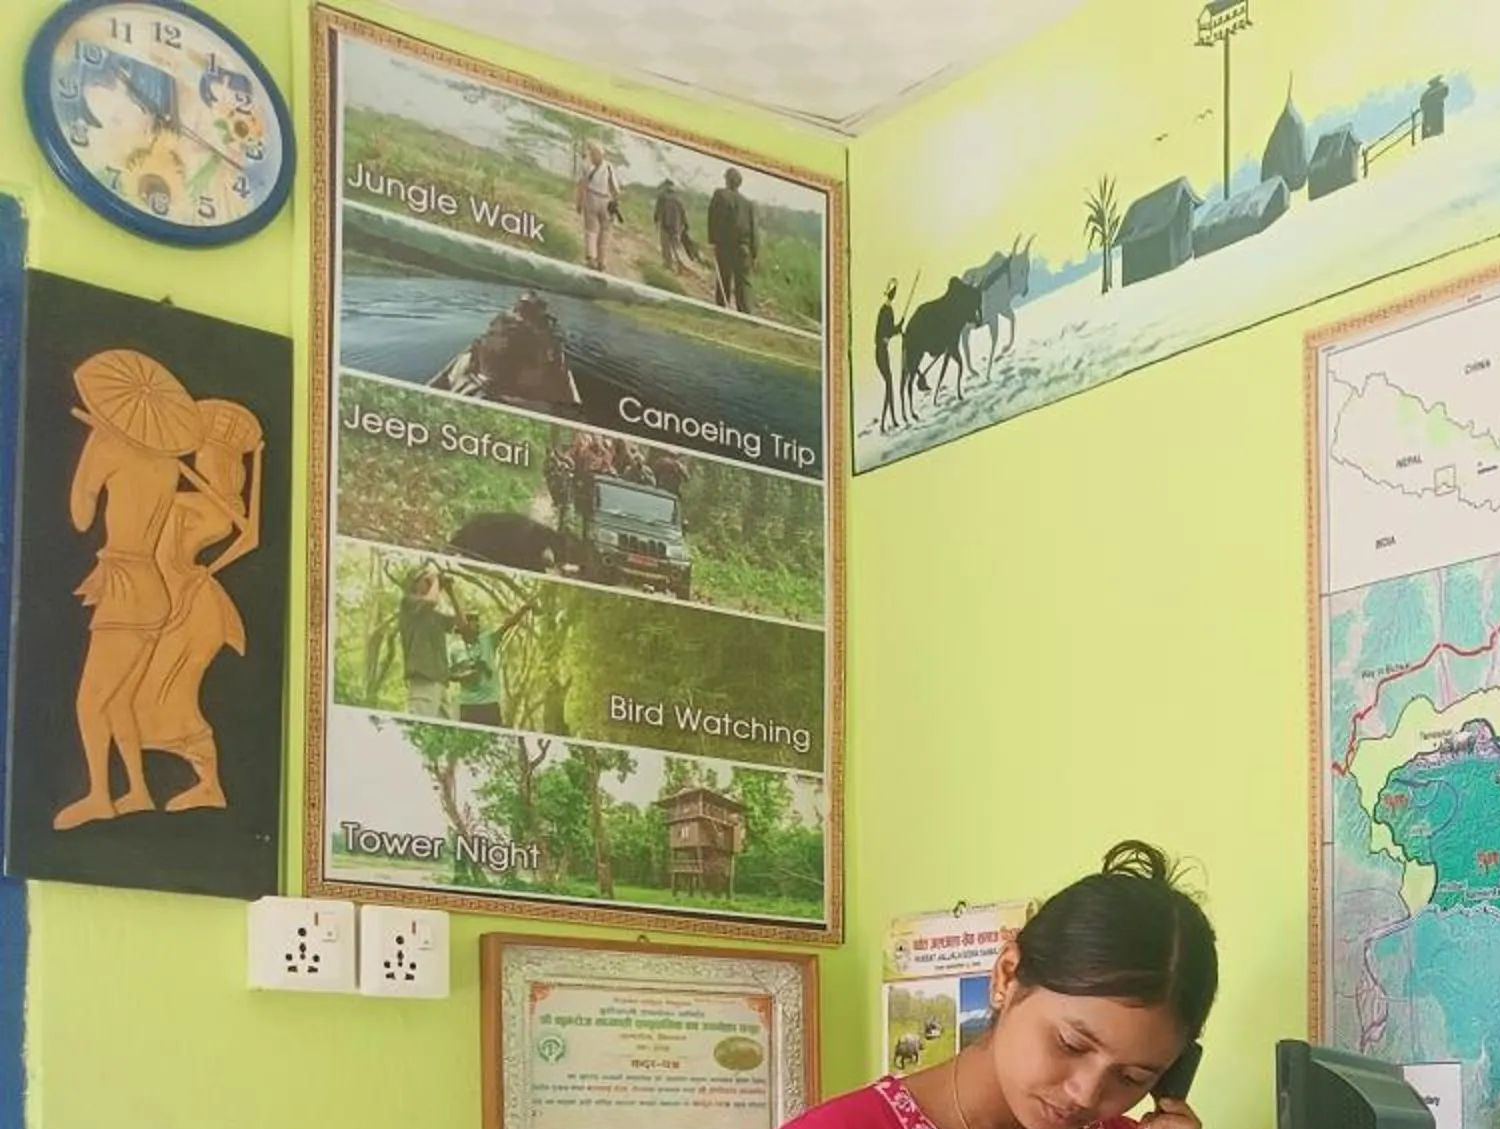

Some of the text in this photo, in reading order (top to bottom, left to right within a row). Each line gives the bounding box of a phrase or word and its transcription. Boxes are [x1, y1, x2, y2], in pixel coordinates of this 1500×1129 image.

[109, 17, 132, 43] 11
[152, 21, 182, 49] 12
[76, 41, 103, 65] 10
[105, 165, 122, 190] 7
[232, 176, 250, 199] 4
[198, 195, 216, 220] 5
[347, 162, 547, 242] Jungle Walk
[1463, 359, 1492, 376] CHINA
[342, 404, 531, 469] Jeep Safari
[618, 396, 816, 470] Canoeing Trip
[1395, 454, 1423, 470] NEPAL
[1374, 535, 1397, 550] INDIA
[608, 692, 813, 752] Bird Watching
[339, 820, 543, 875] Tower Night
